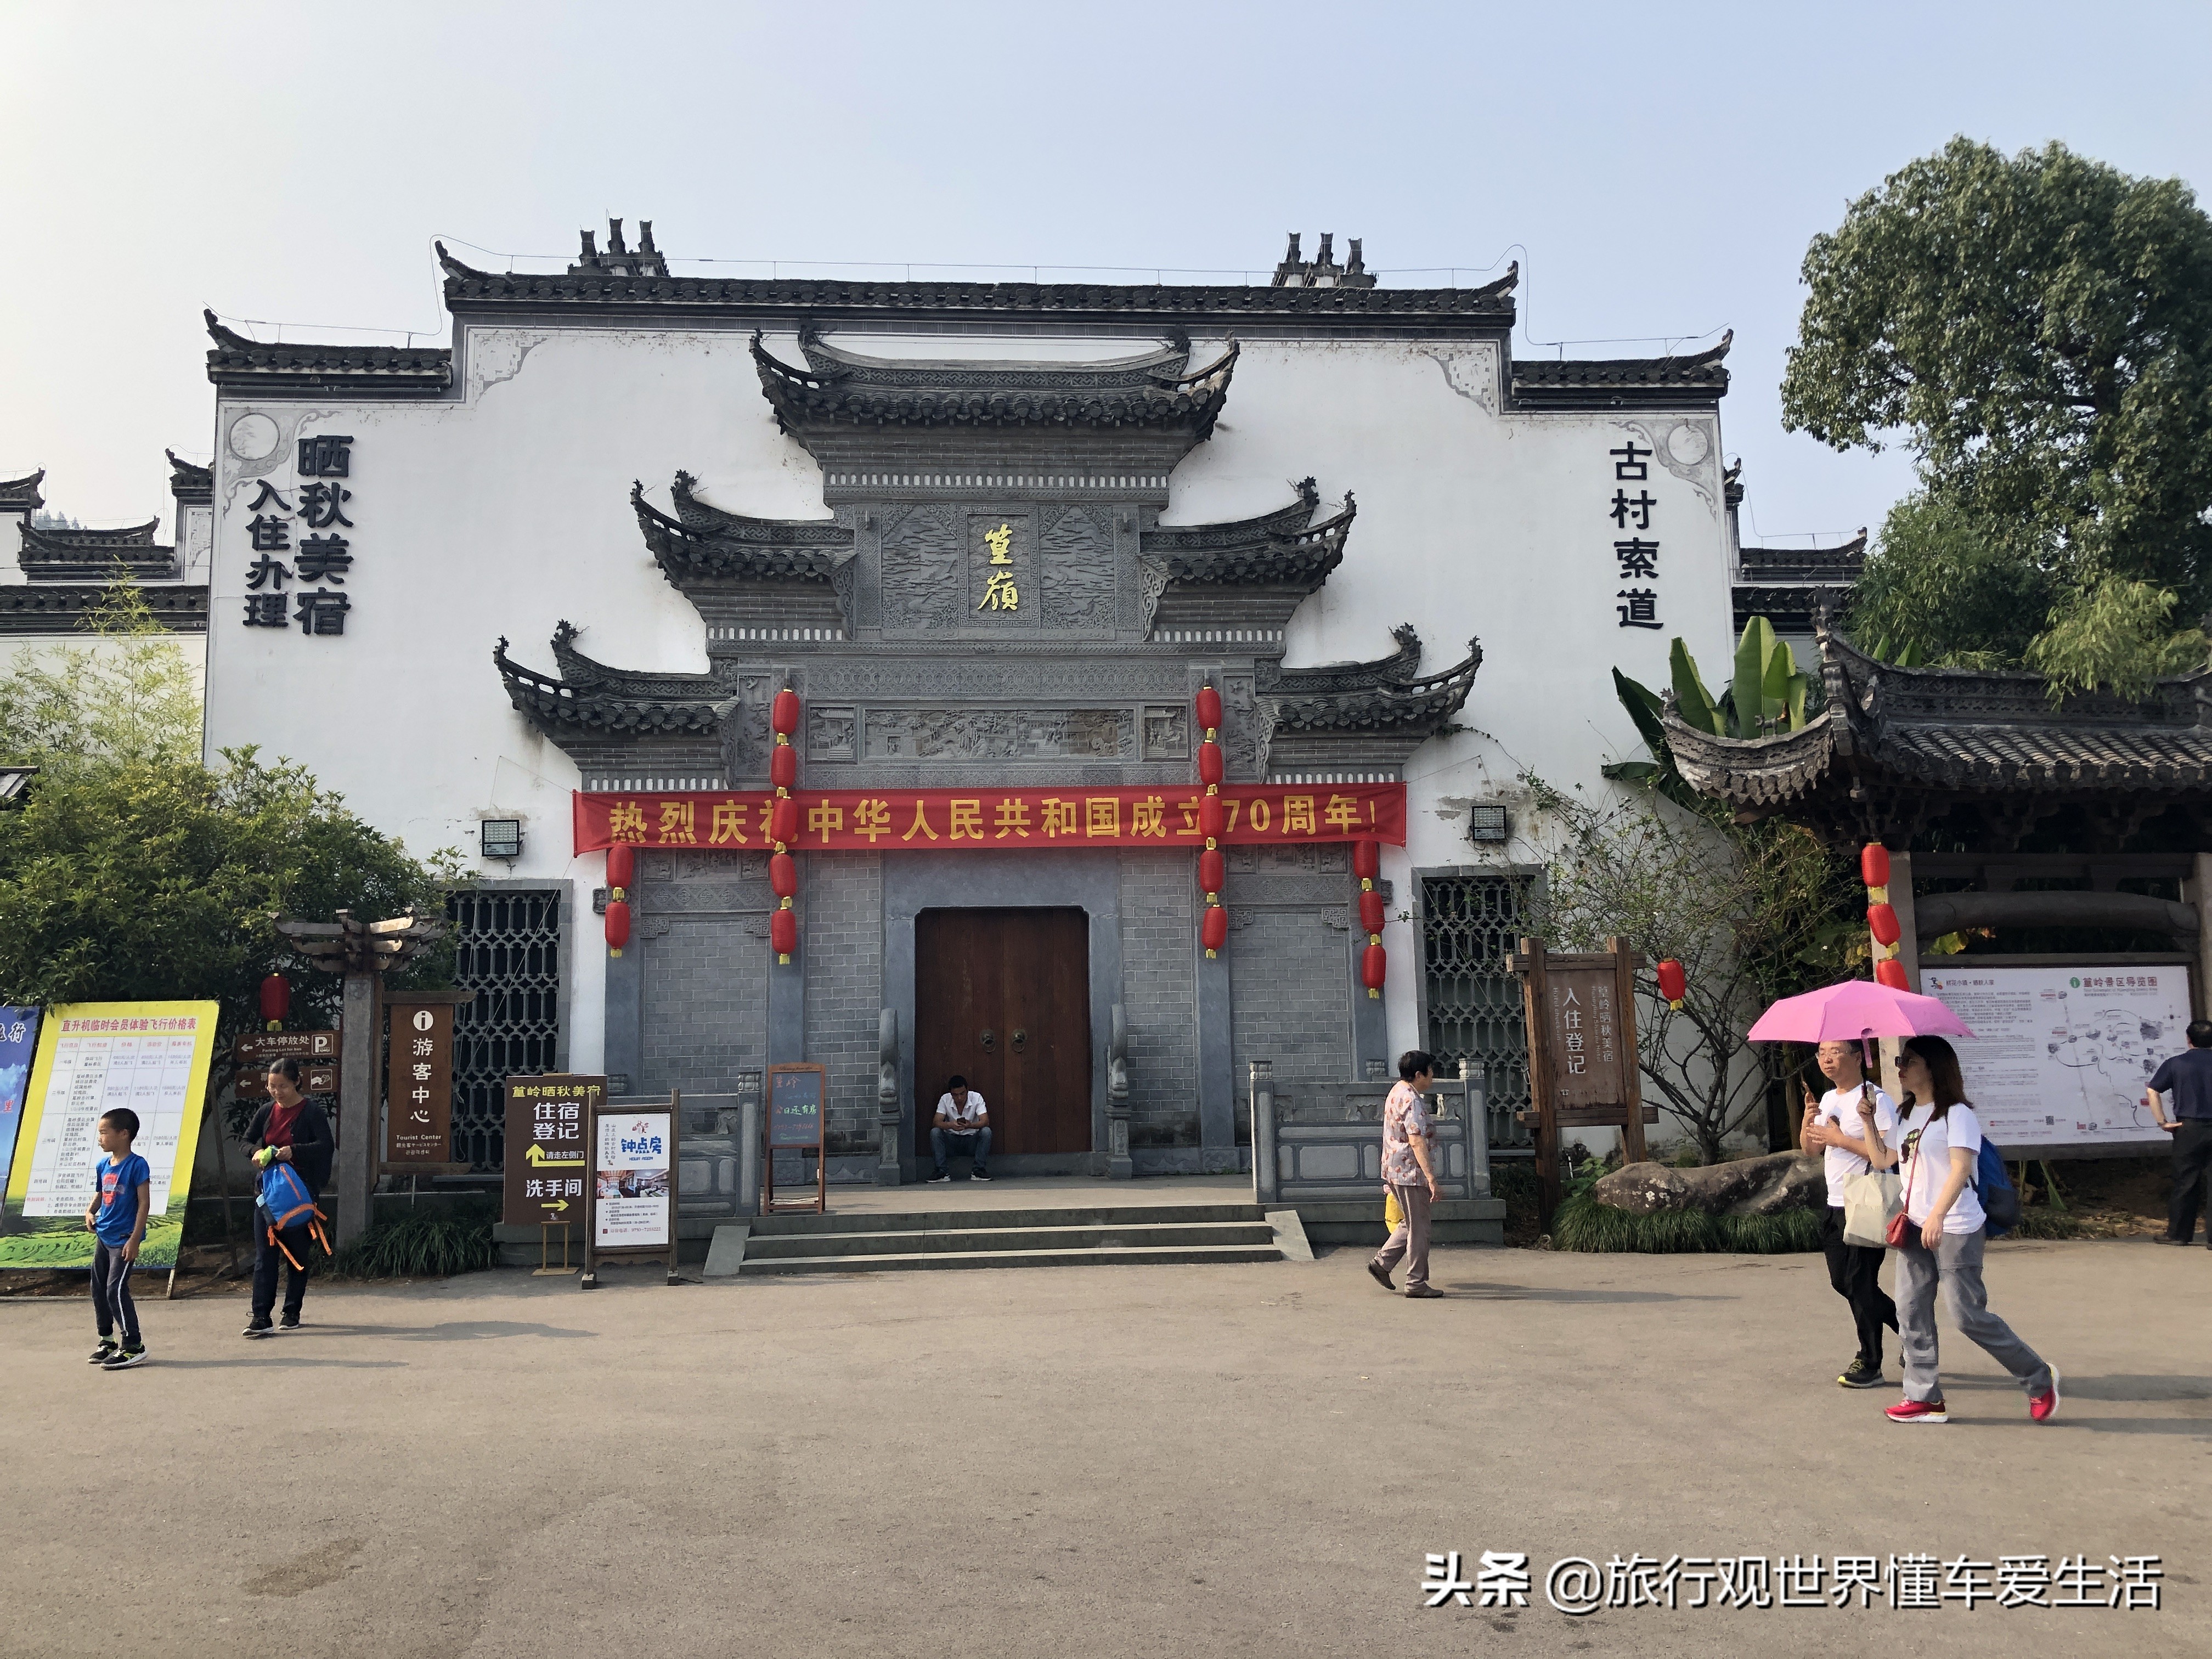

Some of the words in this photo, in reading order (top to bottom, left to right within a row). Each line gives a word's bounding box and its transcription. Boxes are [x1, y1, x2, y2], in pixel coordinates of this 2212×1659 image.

[293, 435, 354, 635] 晒秋美宿
[1610, 441, 1664, 630] 古村索道
[242, 478, 292, 627] 入住办理
[61, 1017, 196, 1032] 直升机临时会员体验飞行价格表
[1563, 988, 1586, 1074] 入住登记
[255, 1035, 309, 1047] 大车停放处
[410, 1037, 433, 1122] 游客中心
[533, 1102, 580, 1120] 住宿
[533, 1122, 579, 1140] 登记
[620, 1136, 662, 1154] 钟点房
[546, 1151, 584, 1160] 请走左侧门
[526, 1179, 582, 1198] 洗手间
